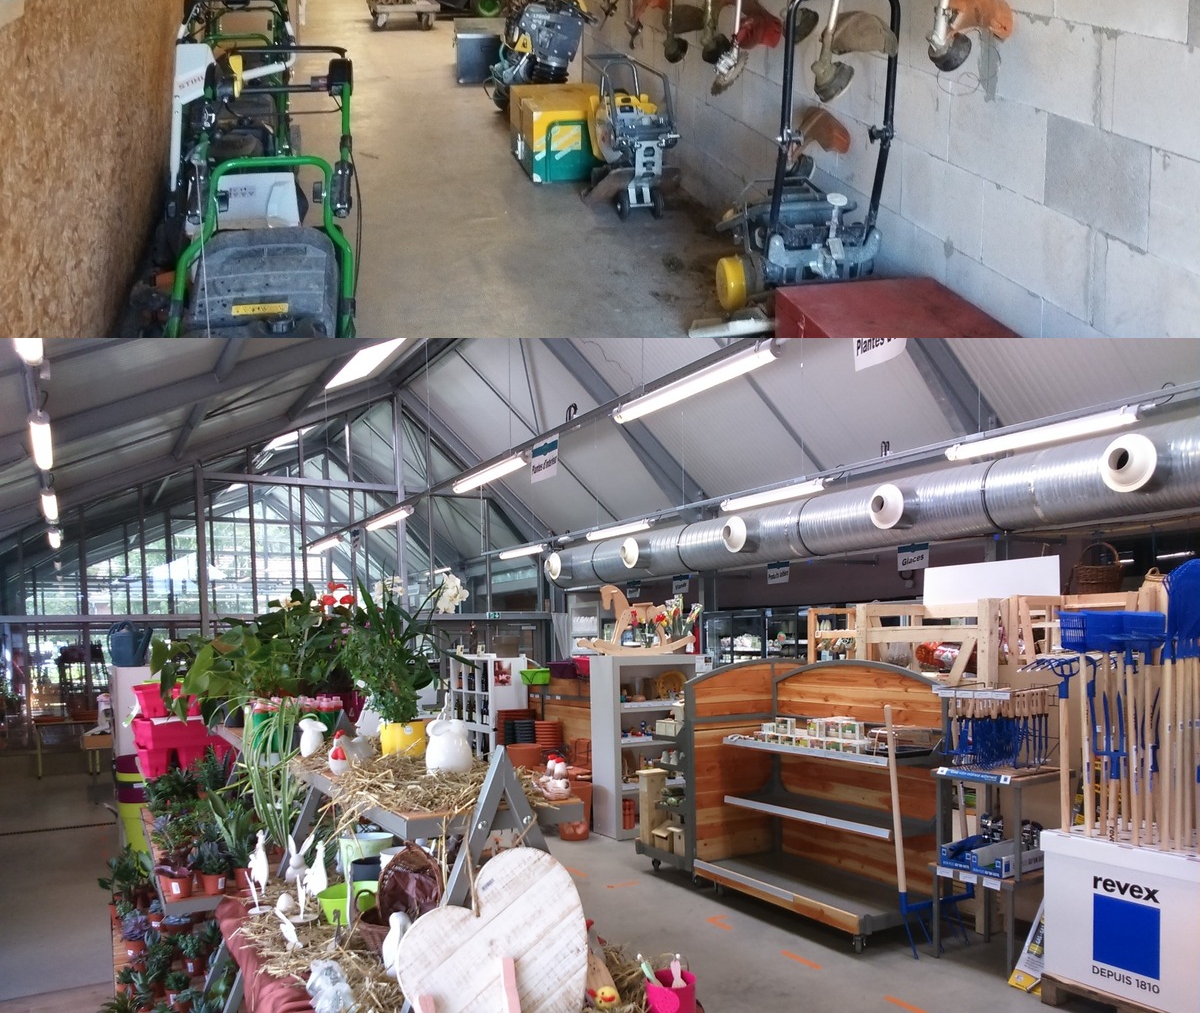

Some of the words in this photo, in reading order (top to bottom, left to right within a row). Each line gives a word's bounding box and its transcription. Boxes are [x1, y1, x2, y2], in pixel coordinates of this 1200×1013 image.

[901, 554, 925, 566] Glaces
[1093, 875, 1160, 904] revex
[1091, 965, 1133, 986] DEPUIS
[1135, 978, 1160, 994] 1810
